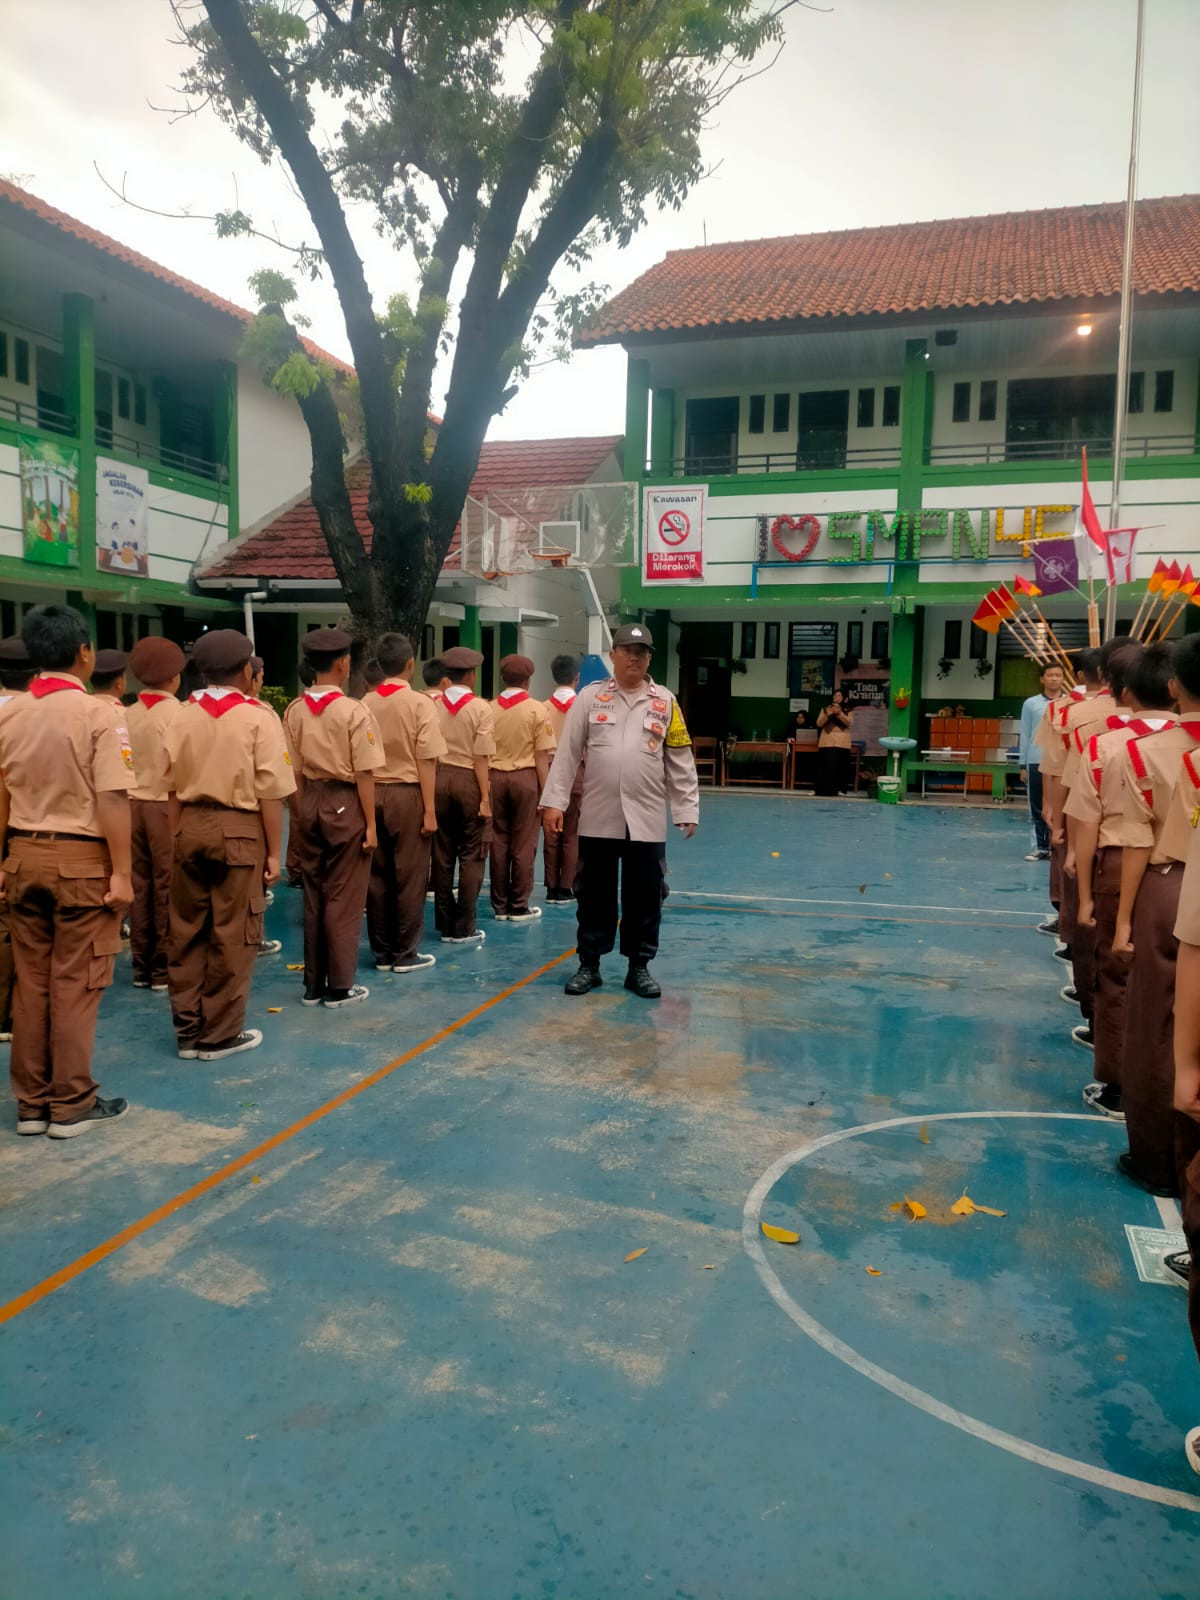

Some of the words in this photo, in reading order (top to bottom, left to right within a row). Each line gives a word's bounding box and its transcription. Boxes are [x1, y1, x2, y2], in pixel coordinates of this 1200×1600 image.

[653, 495, 697, 504] Kawasan
[652, 553, 696, 562] Dilarang
[653, 563, 696, 571] Merokok
[855, 682, 878, 692] Tata
